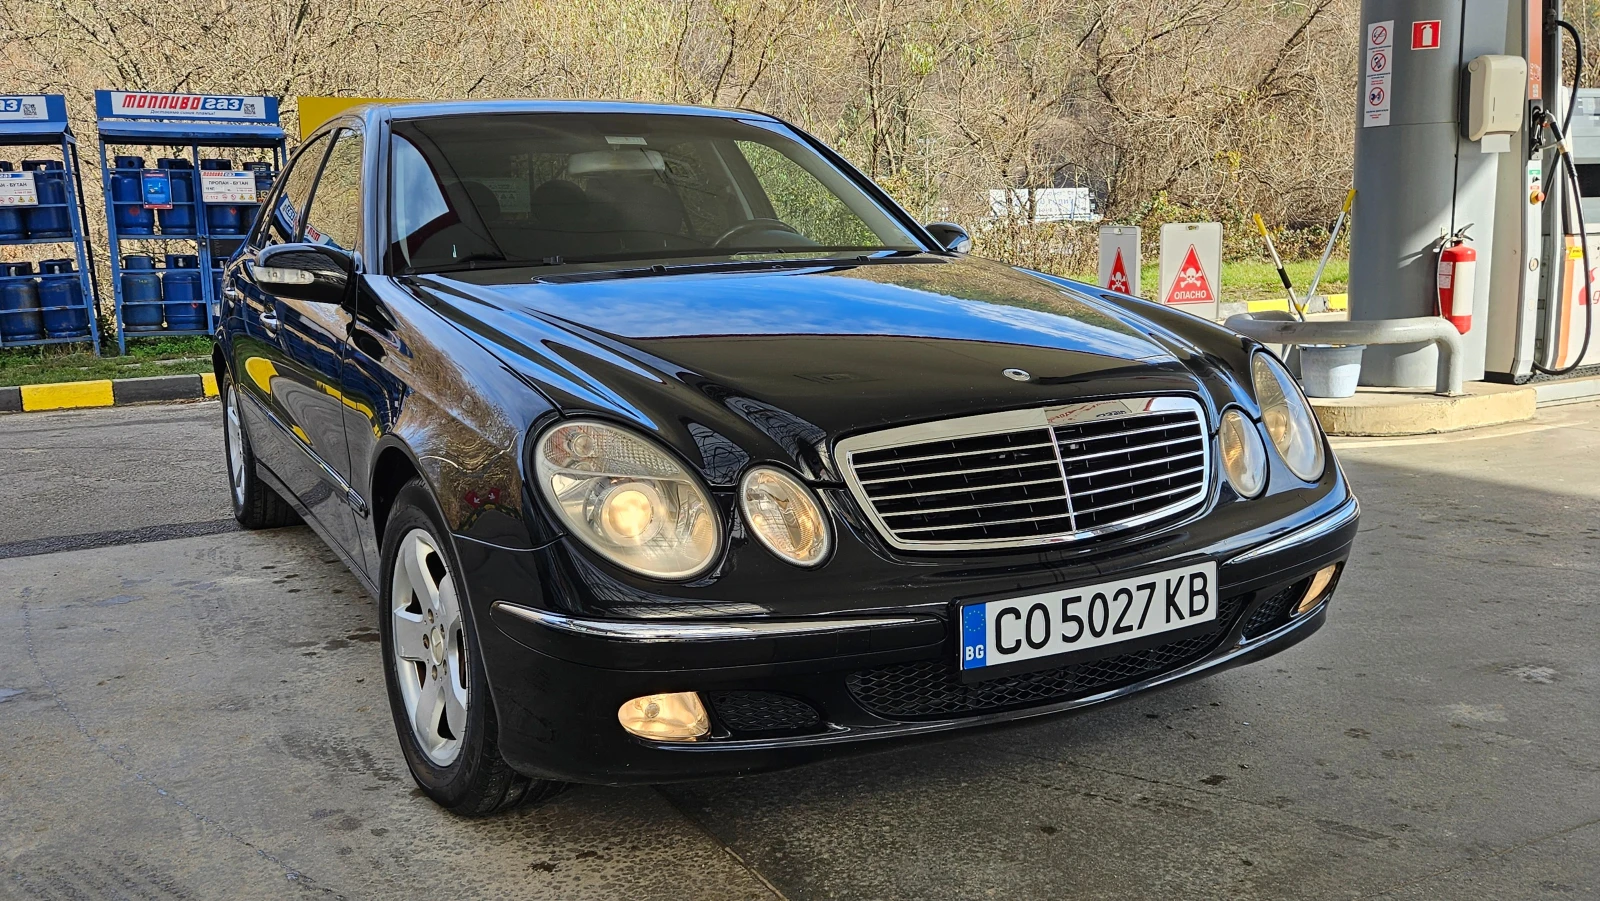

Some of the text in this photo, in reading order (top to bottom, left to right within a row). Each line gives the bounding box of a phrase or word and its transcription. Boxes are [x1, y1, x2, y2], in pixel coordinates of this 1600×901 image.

[1174, 290, 1206, 300] ОПАСНО
[995, 571, 1210, 655] CO 5027 KB
[965, 645, 984, 661] BG
